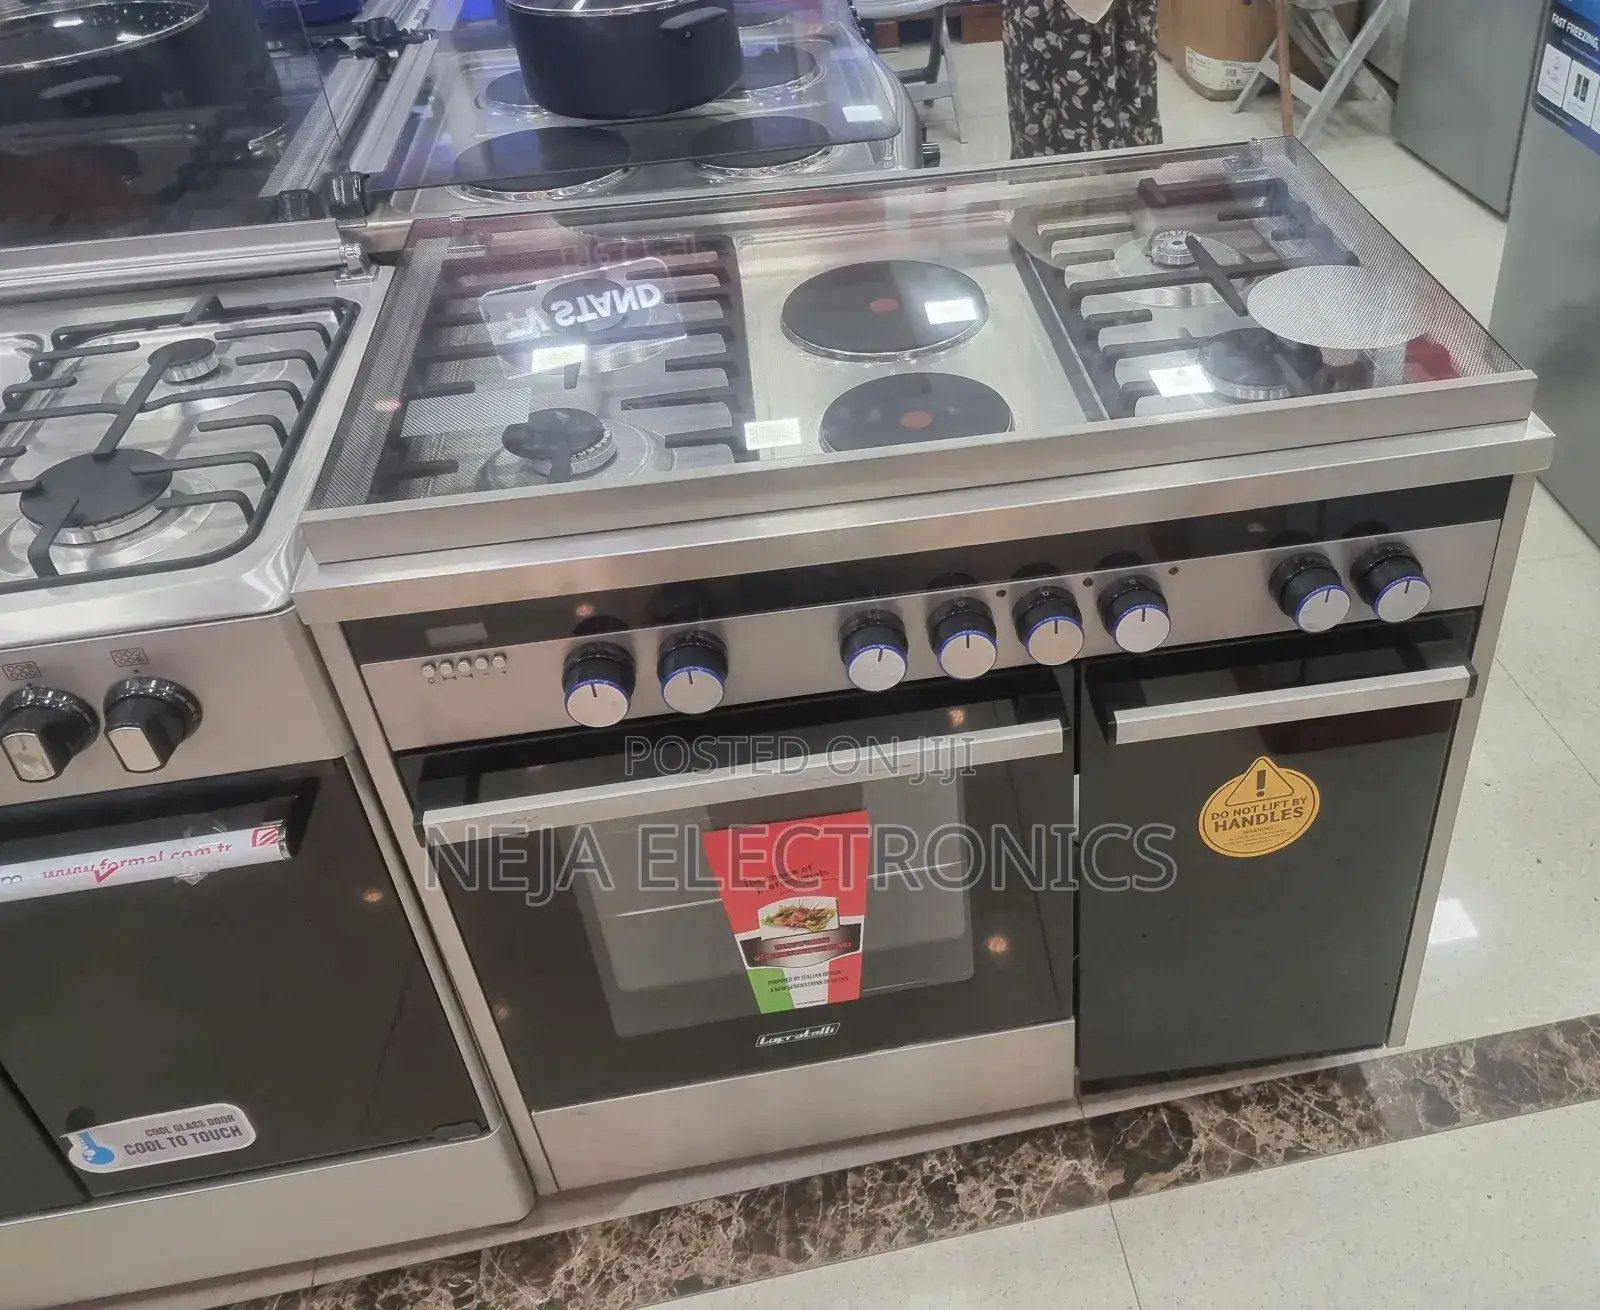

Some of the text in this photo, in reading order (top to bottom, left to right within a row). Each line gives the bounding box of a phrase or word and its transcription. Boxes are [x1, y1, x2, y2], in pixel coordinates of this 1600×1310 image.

[1551, 12, 1567, 29] FAST
[1211, 796, 1308, 821] DO NOT LIFT BY
[1213, 806, 1304, 833] HANDLES
[42, 841, 233, 879] wwwformalcomtr
[801, 864, 813, 874] of
[757, 869, 829, 895] pofonals
[144, 1114, 235, 1137] COOL GLASS DOOR
[123, 1125, 243, 1156] COOL TO TOUCH
